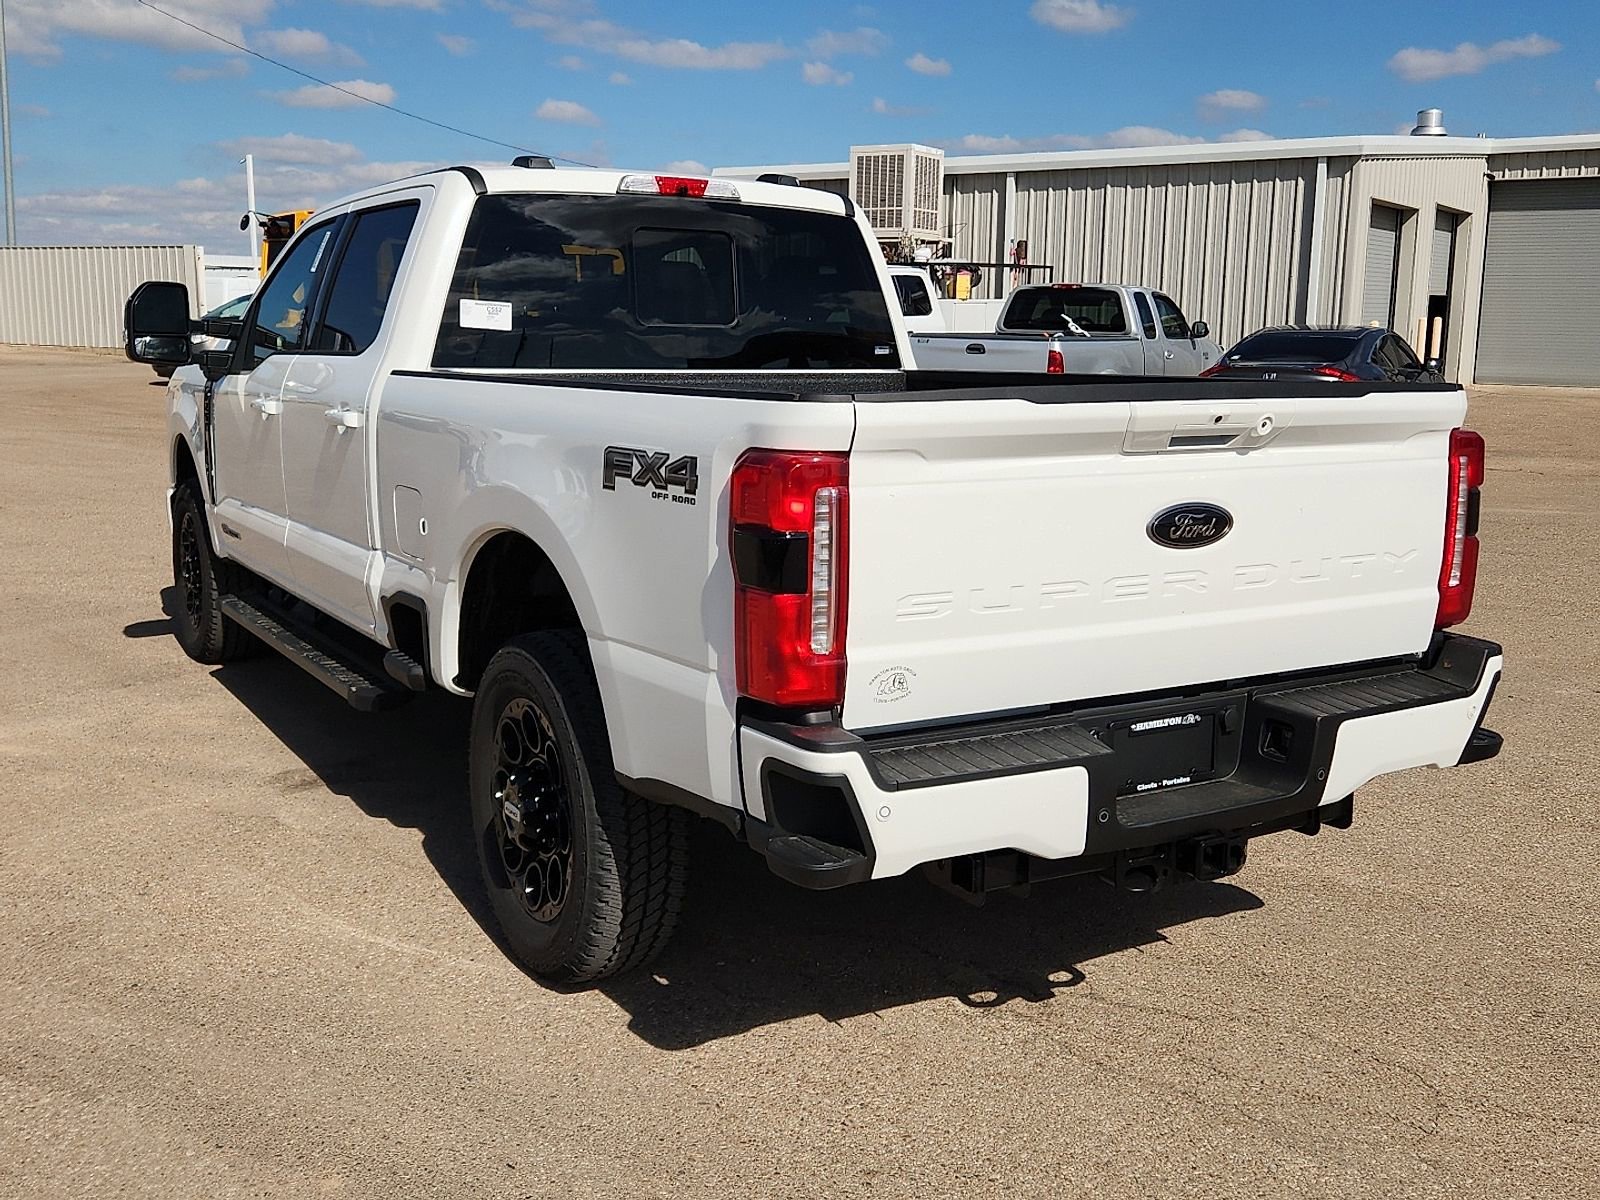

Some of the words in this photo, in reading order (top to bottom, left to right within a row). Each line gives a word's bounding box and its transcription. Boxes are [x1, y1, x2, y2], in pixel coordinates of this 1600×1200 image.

[603, 445, 698, 495] FX4
[651, 491, 669, 501] OFF
[671, 494, 696, 506] ROAD
[1170, 513, 1216, 539] Ford
[896, 569, 1209, 622] SUPER
[1232, 549, 1418, 590] DUTY
[1134, 716, 1182, 731] HAMILTON
